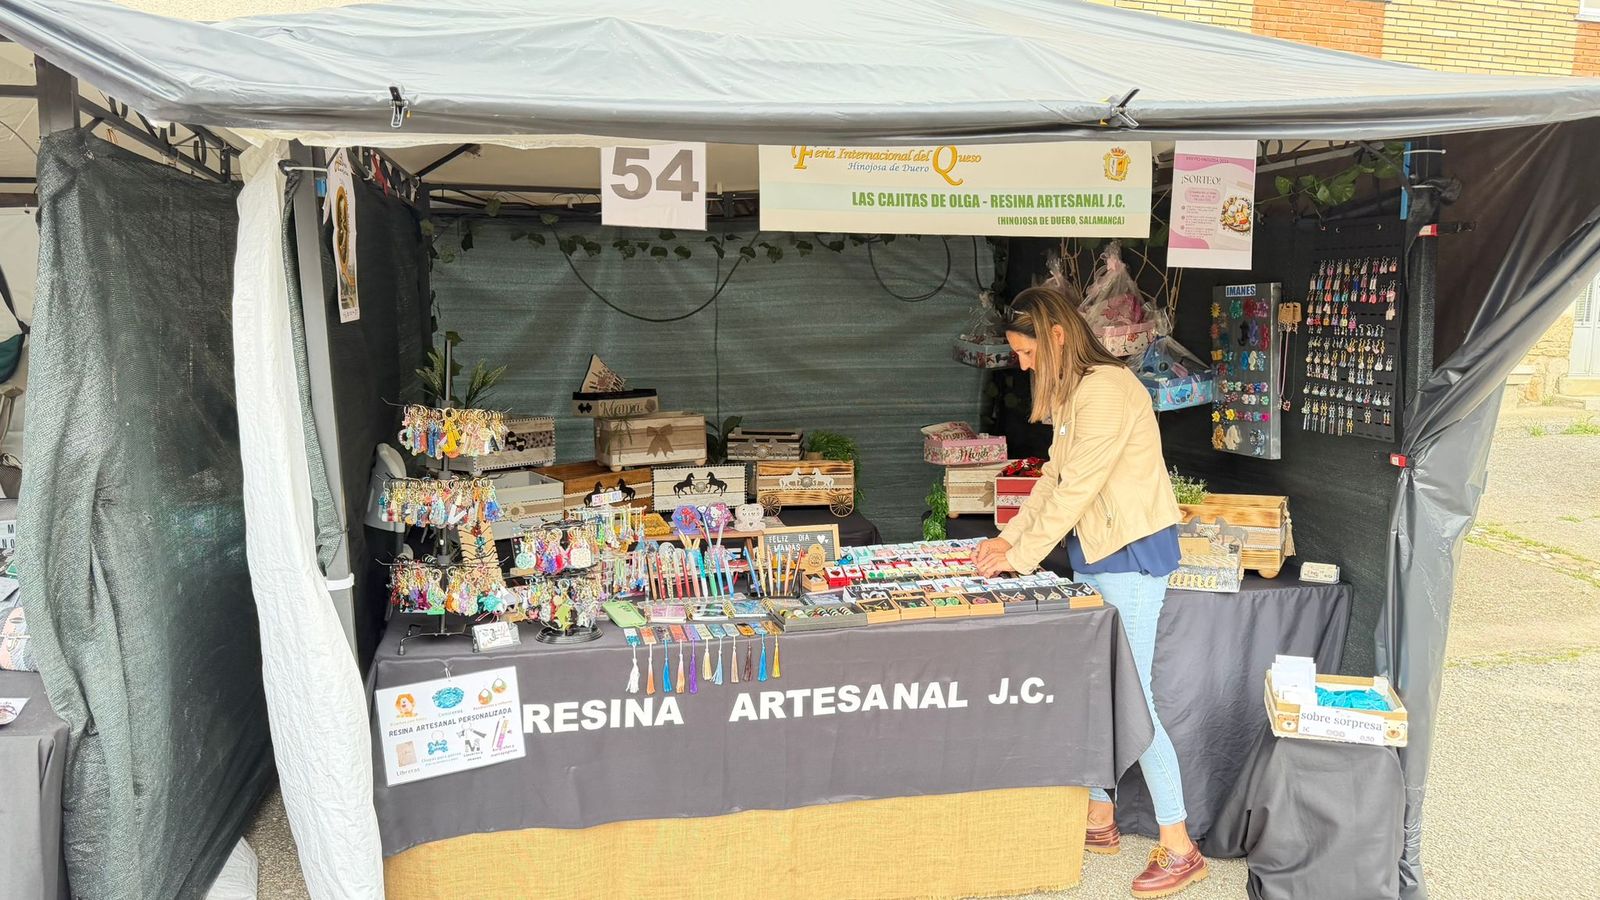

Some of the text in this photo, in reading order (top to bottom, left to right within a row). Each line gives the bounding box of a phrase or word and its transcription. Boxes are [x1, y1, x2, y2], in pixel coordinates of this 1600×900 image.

[610, 146, 699, 202] 54
[791, 145, 982, 186] Feria Internacional del Queso
[848, 162, 930, 174] Hinojosa de Duero
[852, 191, 875, 206] LAS
[878, 192, 928, 207] CAJITAS
[931, 193, 946, 208] DE
[949, 193, 980, 208] OLGA
[990, 194, 1034, 208] RESINA
[1037, 193, 1105, 208] ARTESANAL
[1107, 193, 1125, 208] J.C.
[998, 216, 1125, 226] (HINOJOSA DE DUERO, SALAMANCA)
[1226, 285, 1255, 296] IMANES
[768, 535, 789, 543] FELIZ
[523, 677, 1054, 733] RESINA ARTESANAL J.C.
[388, 728, 414, 737] RESINA
[416, 718, 457, 732] ARTESANAL
[458, 707, 512, 723] PERSONALIZADA
[1301, 712, 1382, 731] sobre sorpresa
